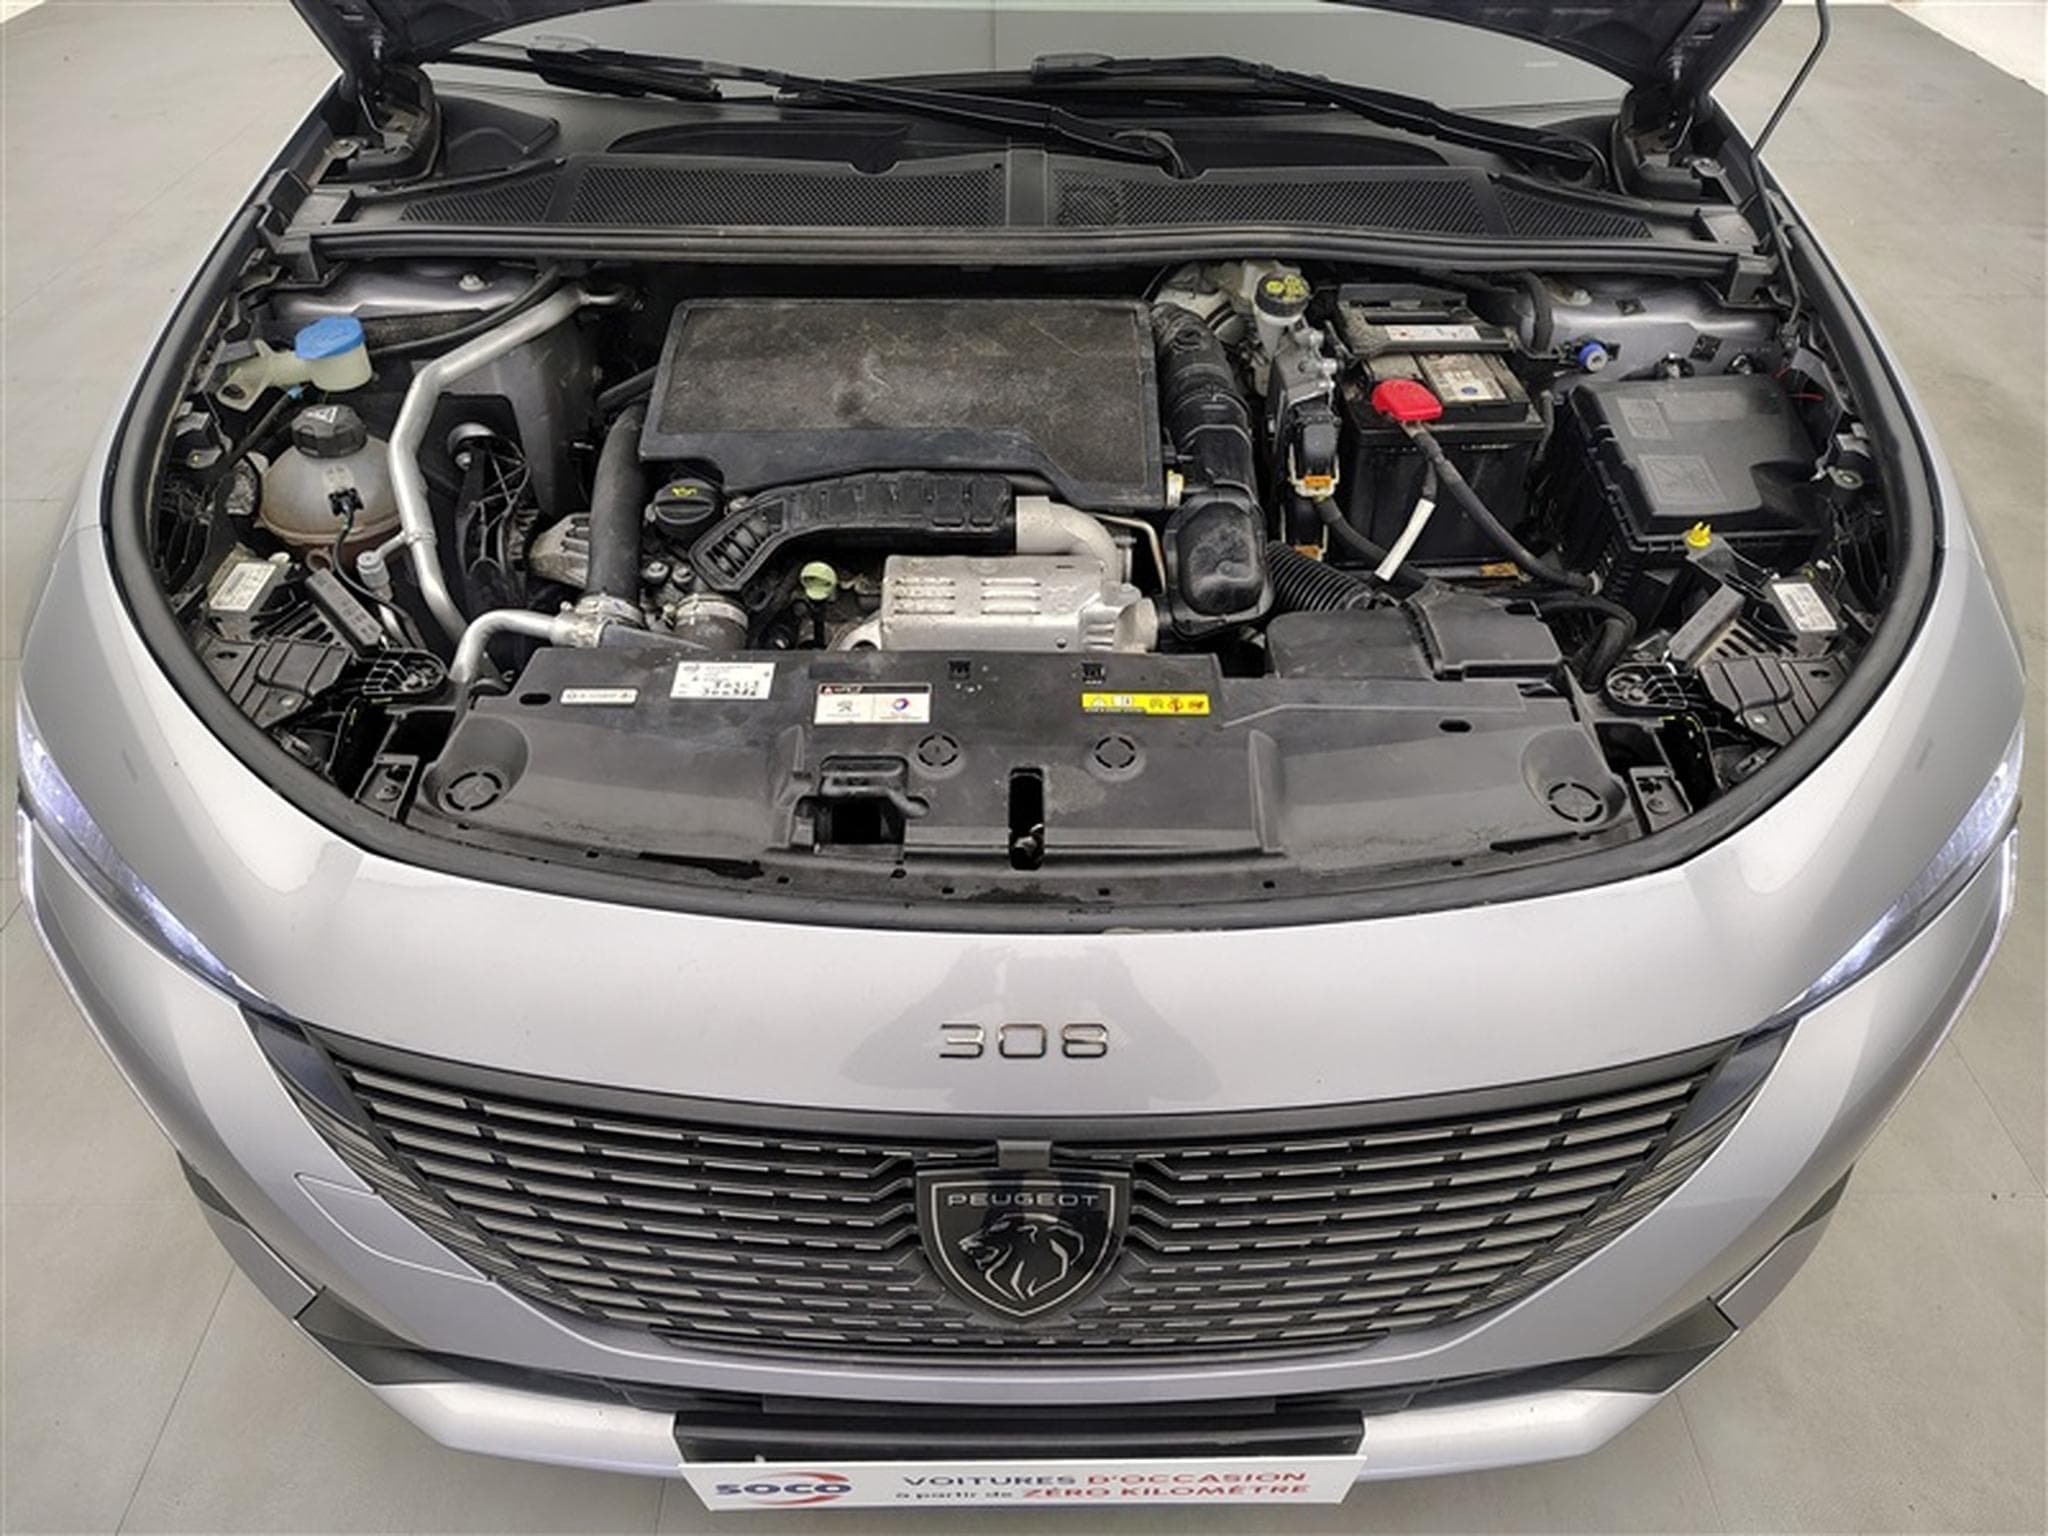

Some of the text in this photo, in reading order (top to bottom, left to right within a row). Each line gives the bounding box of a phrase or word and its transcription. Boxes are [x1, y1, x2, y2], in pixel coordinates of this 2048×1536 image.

[939, 1023, 1108, 1058] 308
[948, 1193, 1099, 1207] PEUGEOT
[903, 1472, 1306, 1485] VOITURES D'OCCASION
[715, 1483, 852, 1495] SOCO
